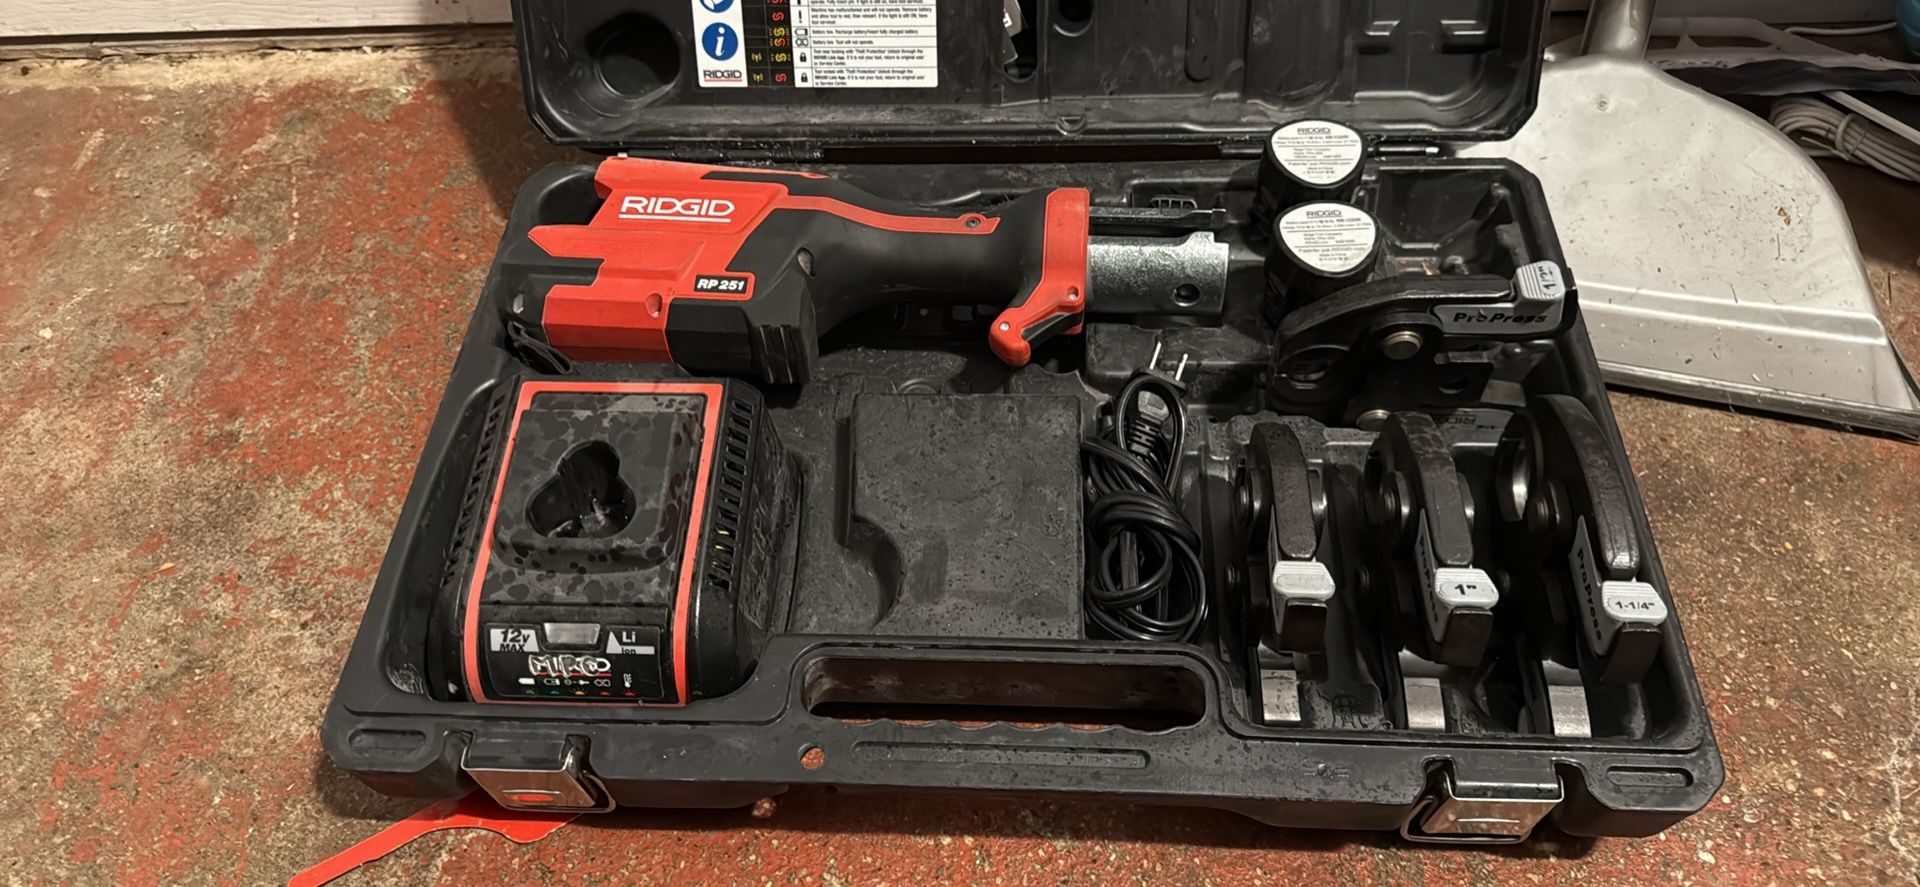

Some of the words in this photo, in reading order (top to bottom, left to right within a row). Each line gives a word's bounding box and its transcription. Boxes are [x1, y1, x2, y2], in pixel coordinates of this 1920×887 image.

[703, 70, 742, 78] RIDGID
[620, 196, 735, 216] RIDGID
[1306, 209, 1342, 217] RIDGID
[697, 278, 718, 290] RP
[718, 280, 745, 291] 251
[622, 631, 636, 643] Li
[500, 643, 526, 652] MAX
